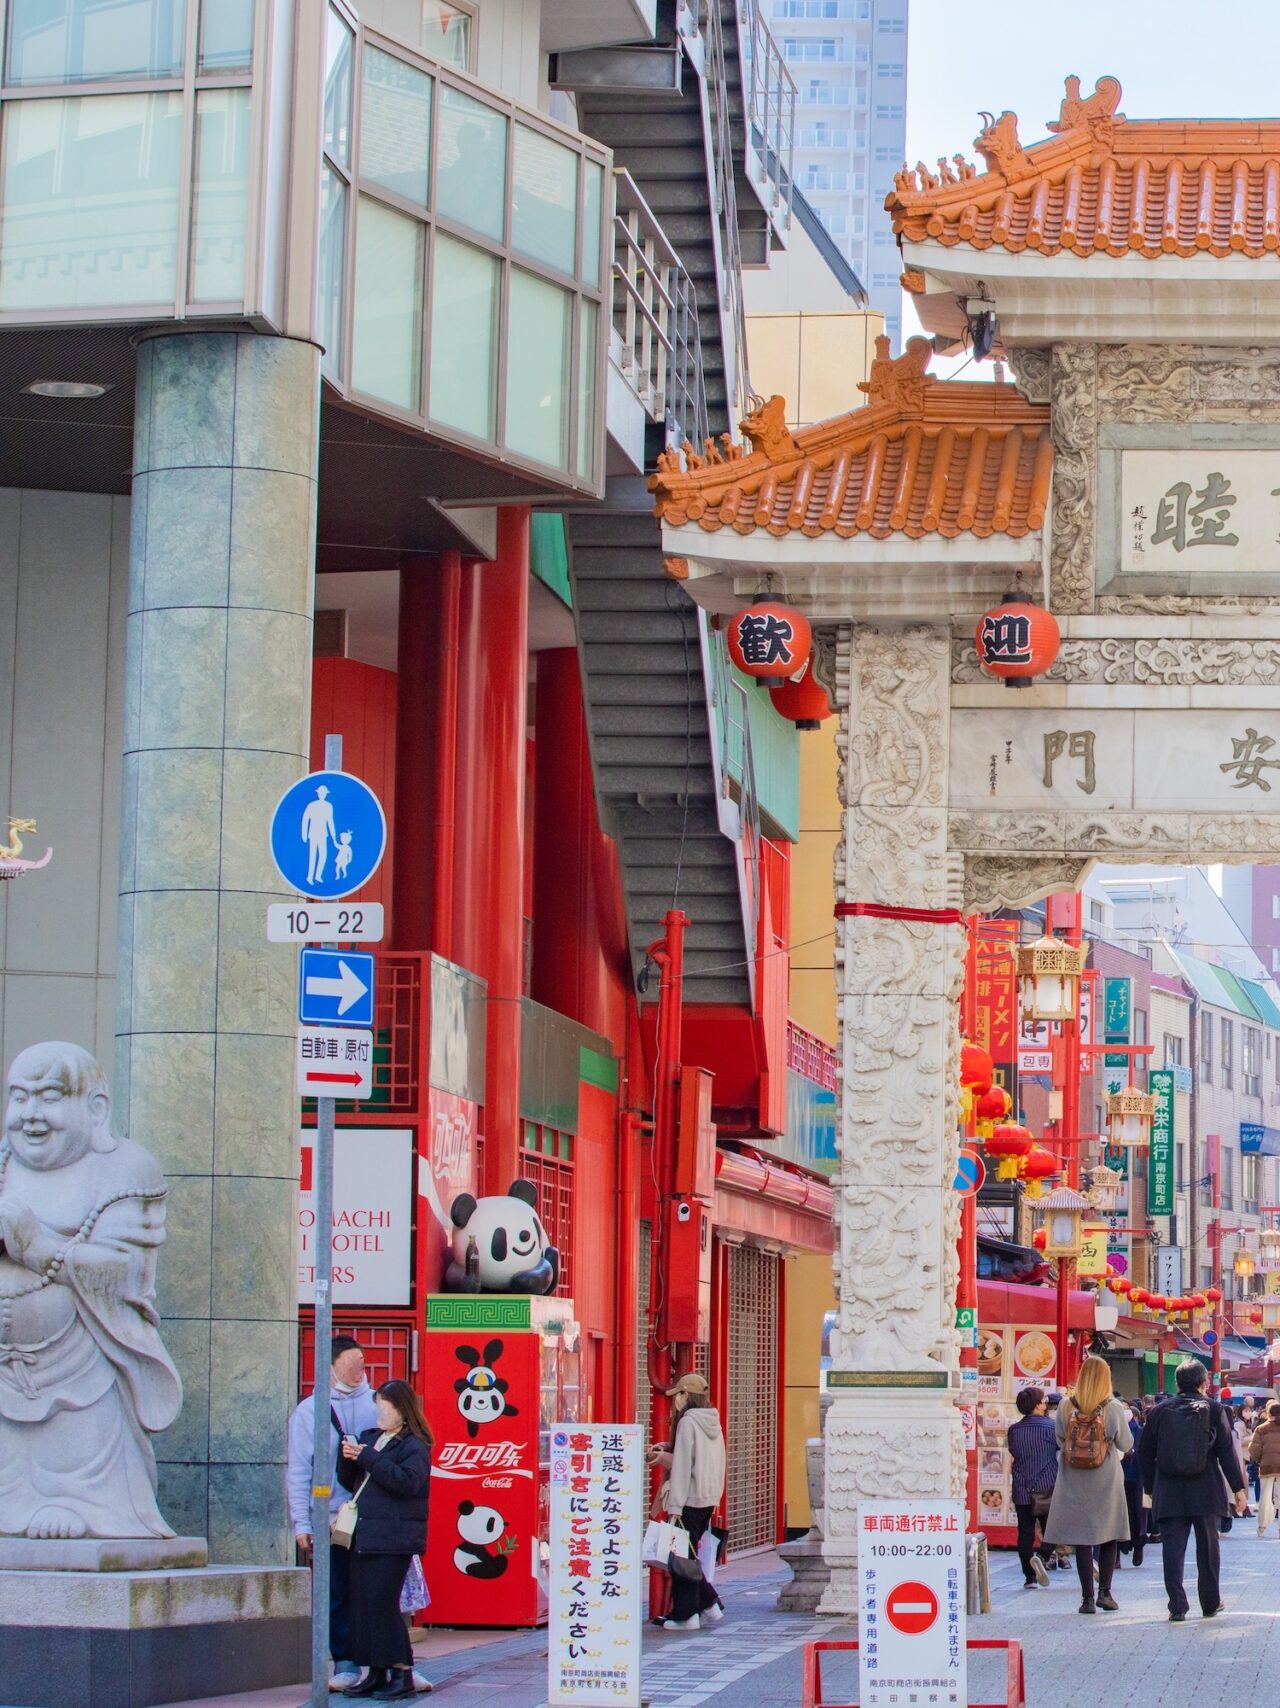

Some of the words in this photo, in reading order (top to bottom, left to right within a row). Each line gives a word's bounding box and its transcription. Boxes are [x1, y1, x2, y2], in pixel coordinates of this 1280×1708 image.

[300, 1209, 391, 1228] OACHI
[331, 1234, 384, 1252] OTEL
[300, 1266, 355, 1284] ETRS
[568, 1433, 594, 1659] 客引きにご注意ください
[601, 1434, 624, 1598] 迷惑となるような
[863, 1514, 959, 1532] 車両通行禁止
[865, 1568, 878, 1669] 歩行者専用道路
[947, 1567, 960, 1668] 自転車も乗れません
